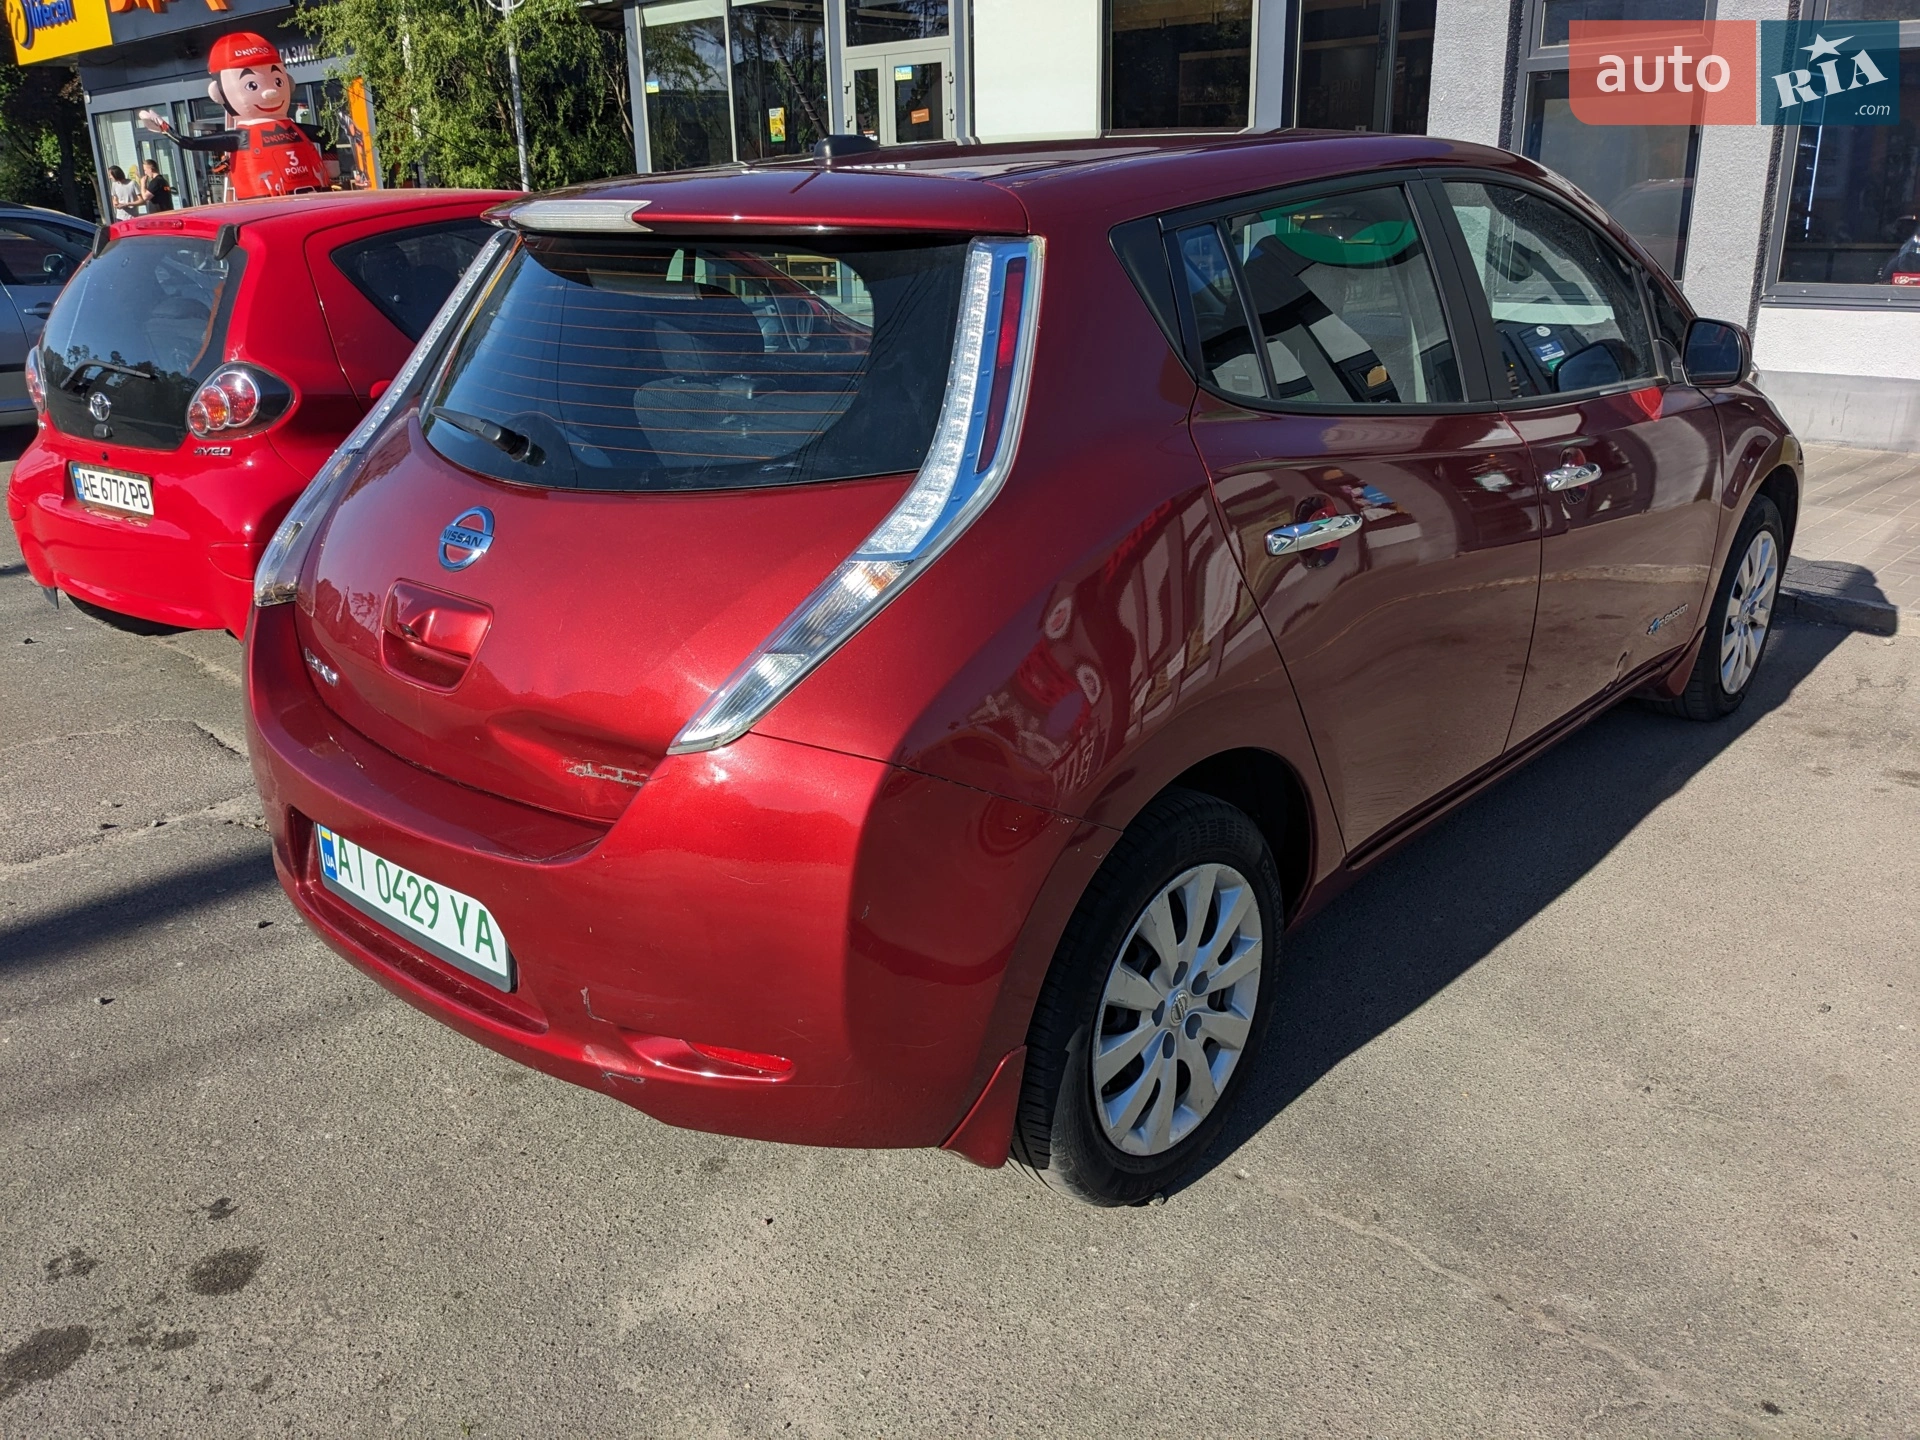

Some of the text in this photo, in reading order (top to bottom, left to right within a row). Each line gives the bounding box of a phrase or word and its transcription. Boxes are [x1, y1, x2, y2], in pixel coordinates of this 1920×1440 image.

[285, 150, 299, 166] 3
[284, 165, 309, 176] РОКИ
[81, 472, 150, 510] AE 6772 PB
[442, 528, 483, 548] NISSAN
[324, 851, 337, 872] UA
[375, 858, 440, 930] 0429
[449, 894, 498, 963] YA
